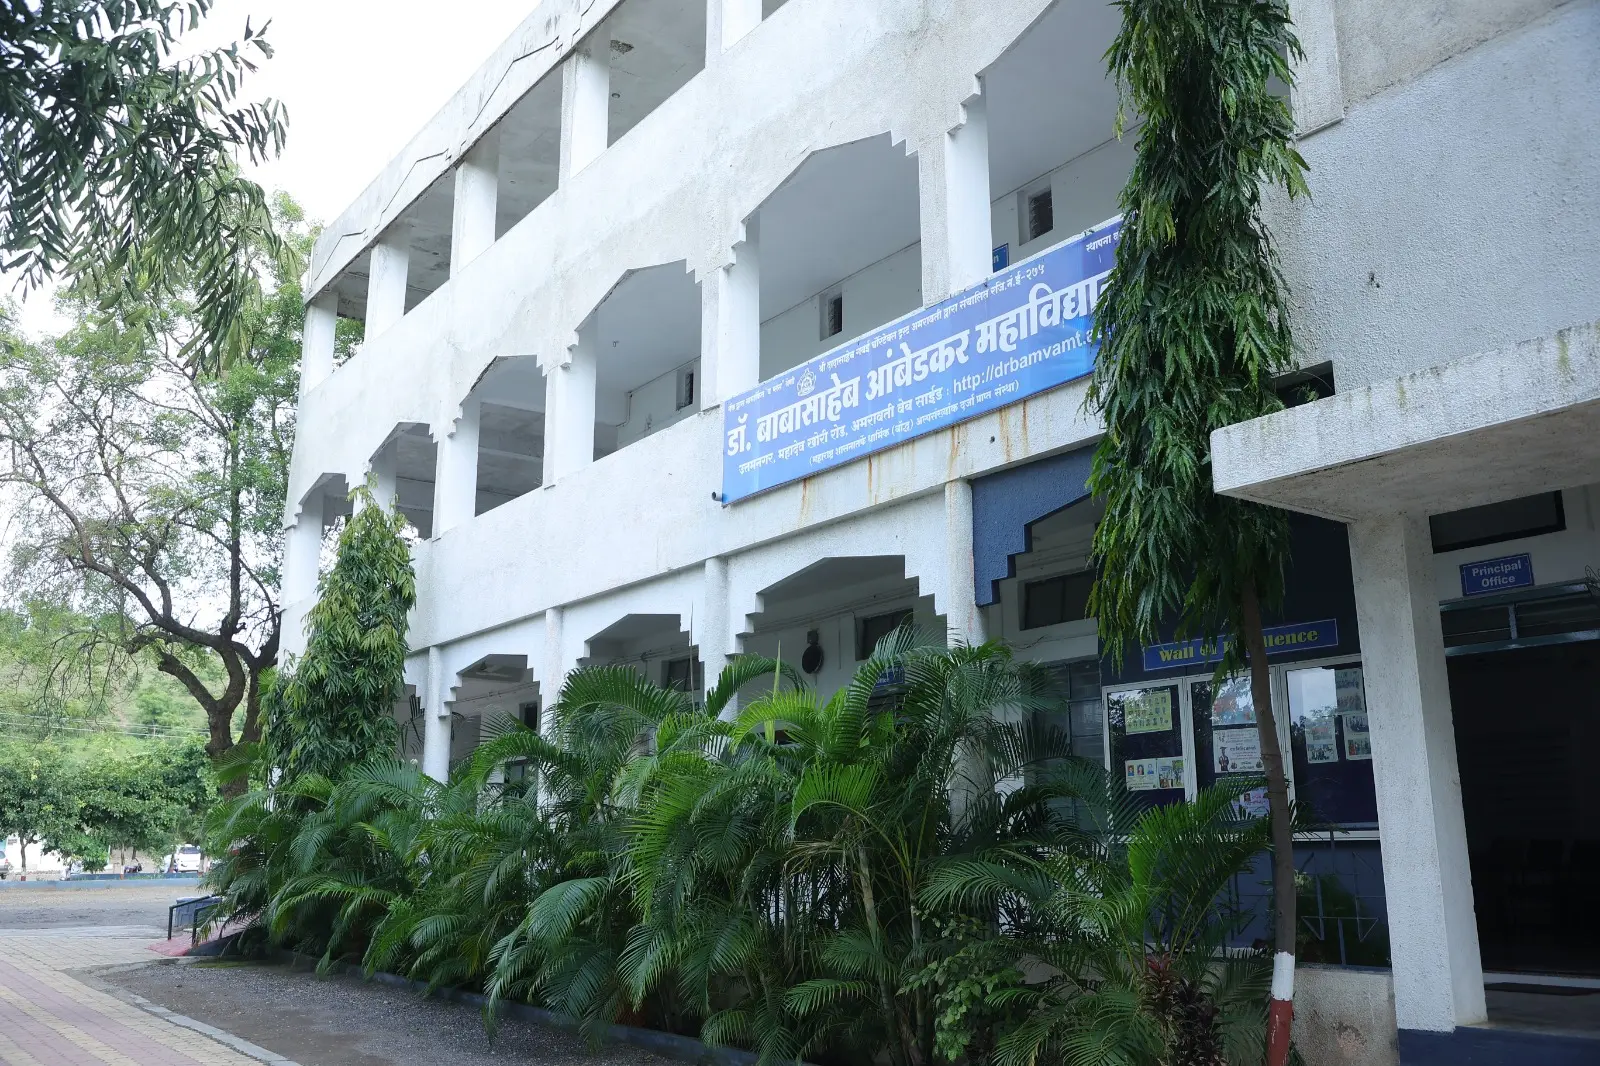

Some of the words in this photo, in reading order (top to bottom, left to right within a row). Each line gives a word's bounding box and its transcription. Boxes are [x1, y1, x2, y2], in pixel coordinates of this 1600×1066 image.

[1085, 234, 1111, 252] स्थापना
[911, 308, 942, 331] अमरावती
[943, 303, 958, 319] द्वारा
[959, 289, 989, 310] संचालित
[727, 413, 752, 456] डॉ.
[757, 373, 860, 443] बाबासाहेब
[865, 329, 970, 401] आंबेडकर
[975, 265, 1117, 354] महाविद्या
[778, 439, 805, 460] महादेव
[807, 429, 828, 450] खोरी
[831, 424, 848, 441] रोड,
[851, 405, 895, 431] अमरावती
[915, 384, 943, 408] साईड
[868, 427, 890, 443] धार्मिक
[959, 393, 975, 411] दर्जा
[976, 391, 992, 404] प्राप्त
[994, 380, 1019, 397] संस्था)
[1472, 559, 1522, 576] Principal
[1481, 575, 1516, 587] Office
[1160, 646, 1194, 662] Wall
